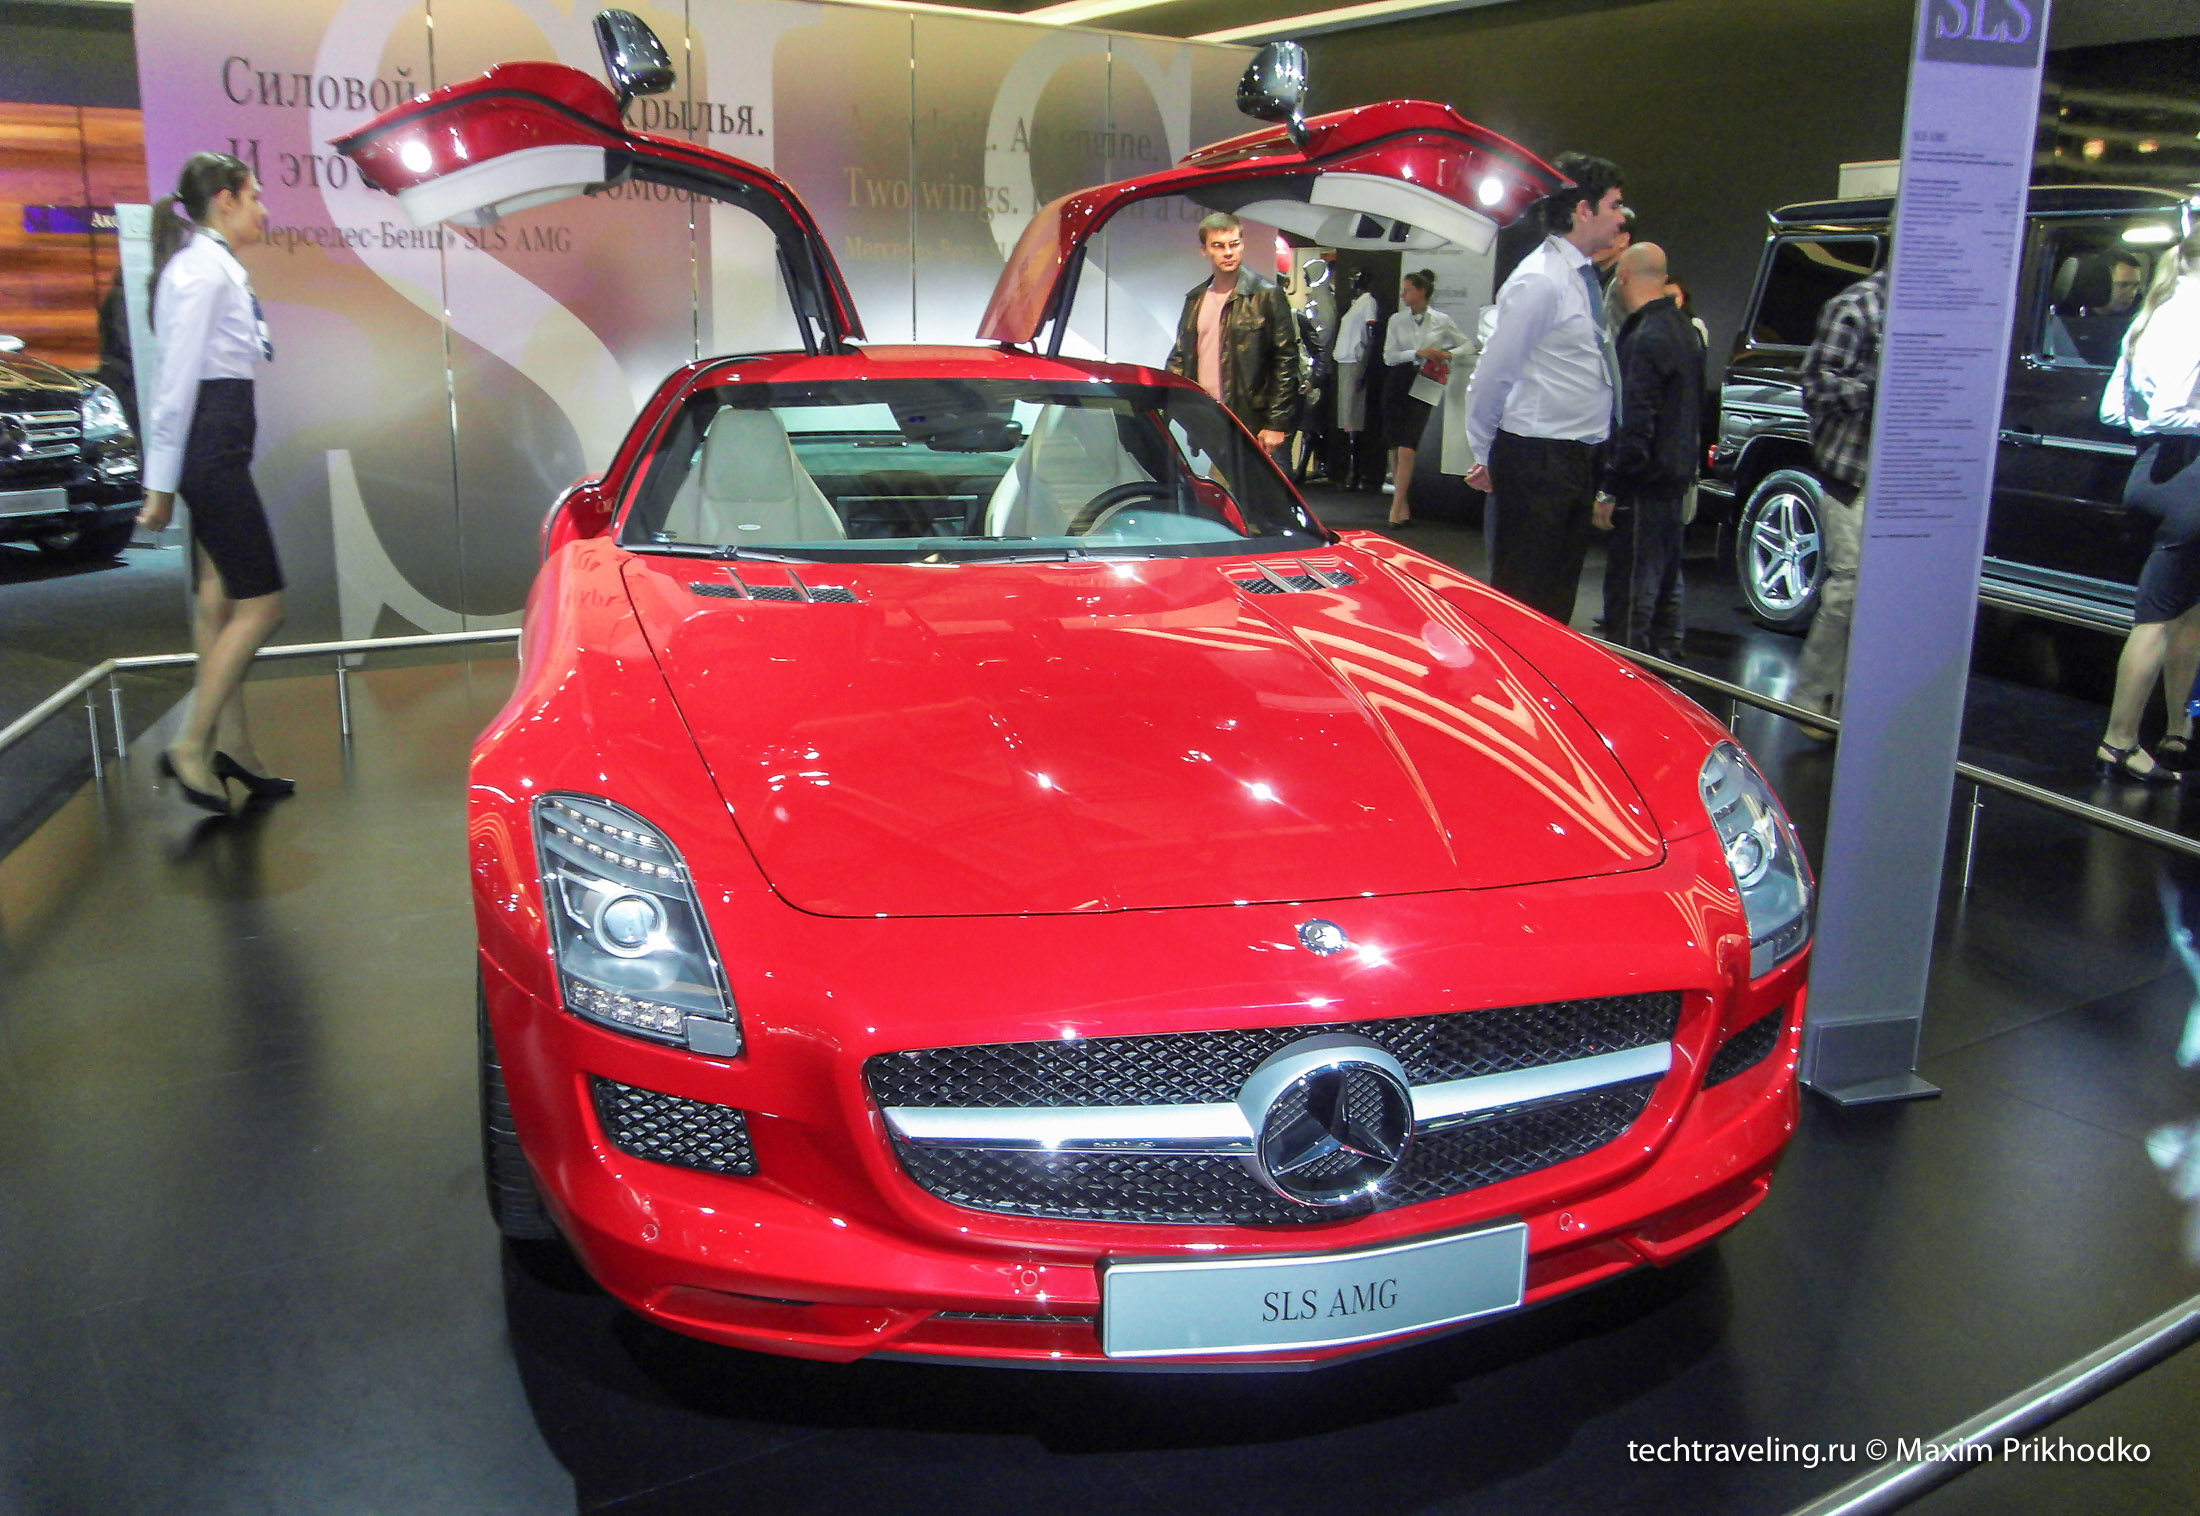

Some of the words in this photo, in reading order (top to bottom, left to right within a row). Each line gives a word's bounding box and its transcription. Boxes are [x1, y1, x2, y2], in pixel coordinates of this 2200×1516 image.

[279, 151, 349, 189] это
[844, 167, 908, 209] Two
[921, 175, 1020, 223] wings.
[464, 225, 508, 252] SLS
[515, 227, 571, 253] AMG
[1262, 1288, 1318, 1322] SLS
[1328, 1278, 1398, 1318] AMG
